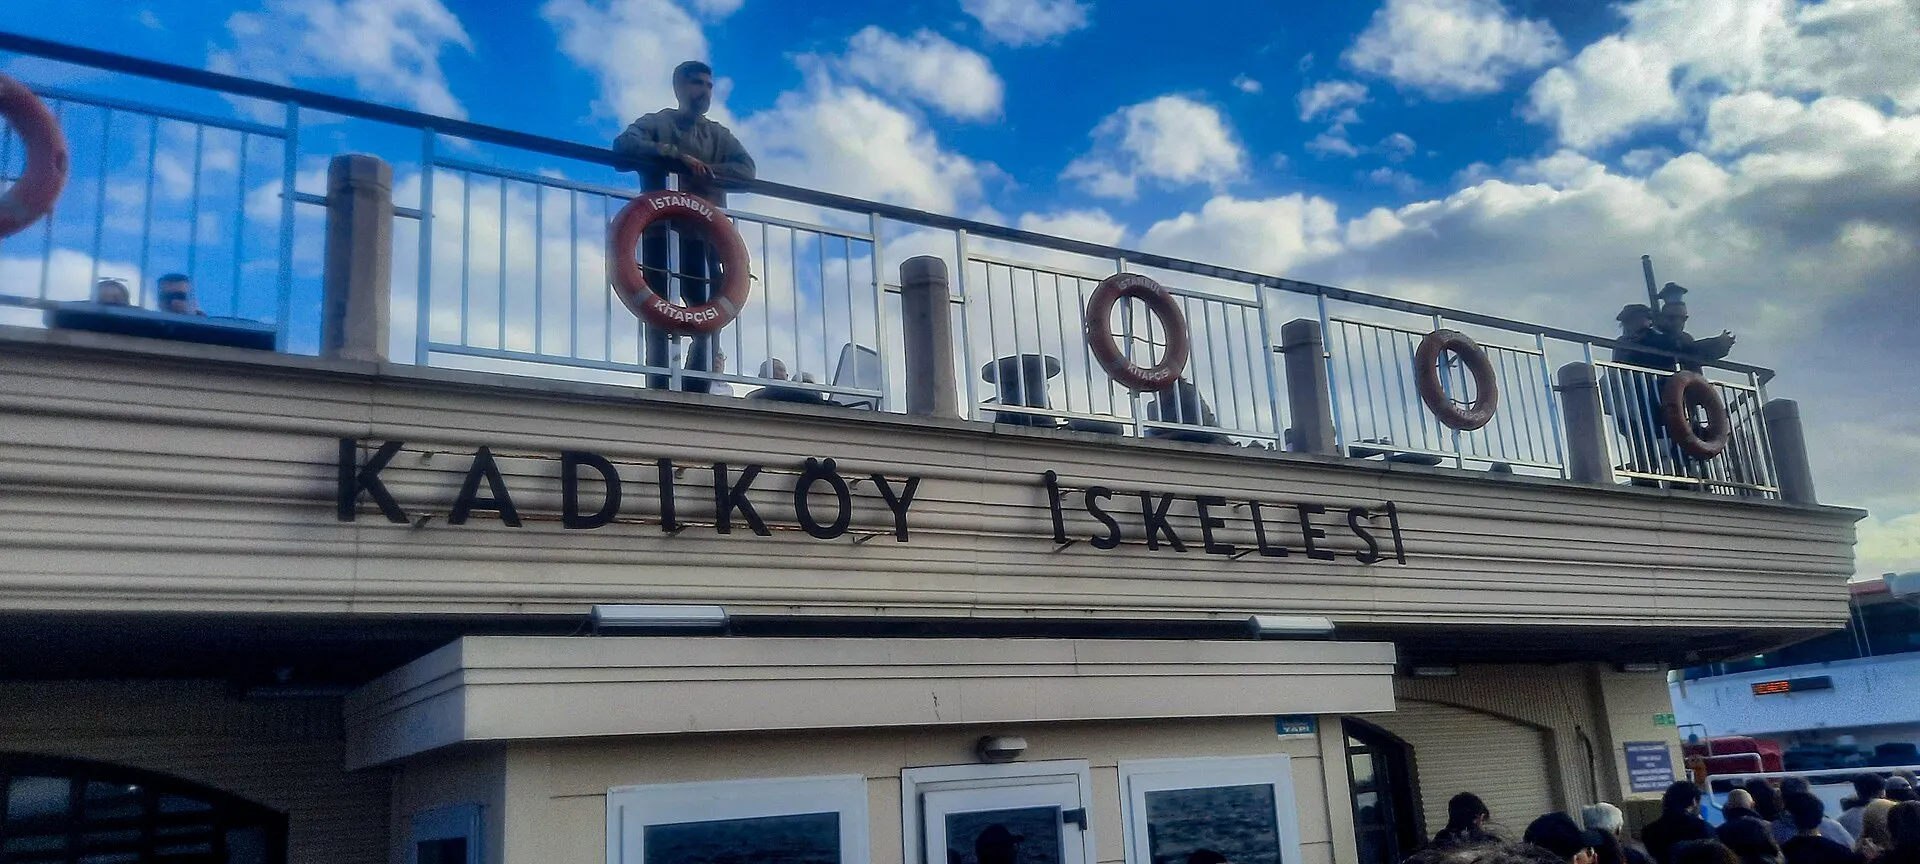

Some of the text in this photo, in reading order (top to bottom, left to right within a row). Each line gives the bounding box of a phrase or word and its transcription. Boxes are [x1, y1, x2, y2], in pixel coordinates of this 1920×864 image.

[648, 194, 715, 222] İSTANBUL
[654, 300, 719, 325] KİTAPÇISI
[337, 437, 1406, 566] KADIKÖY İSKELESİ
